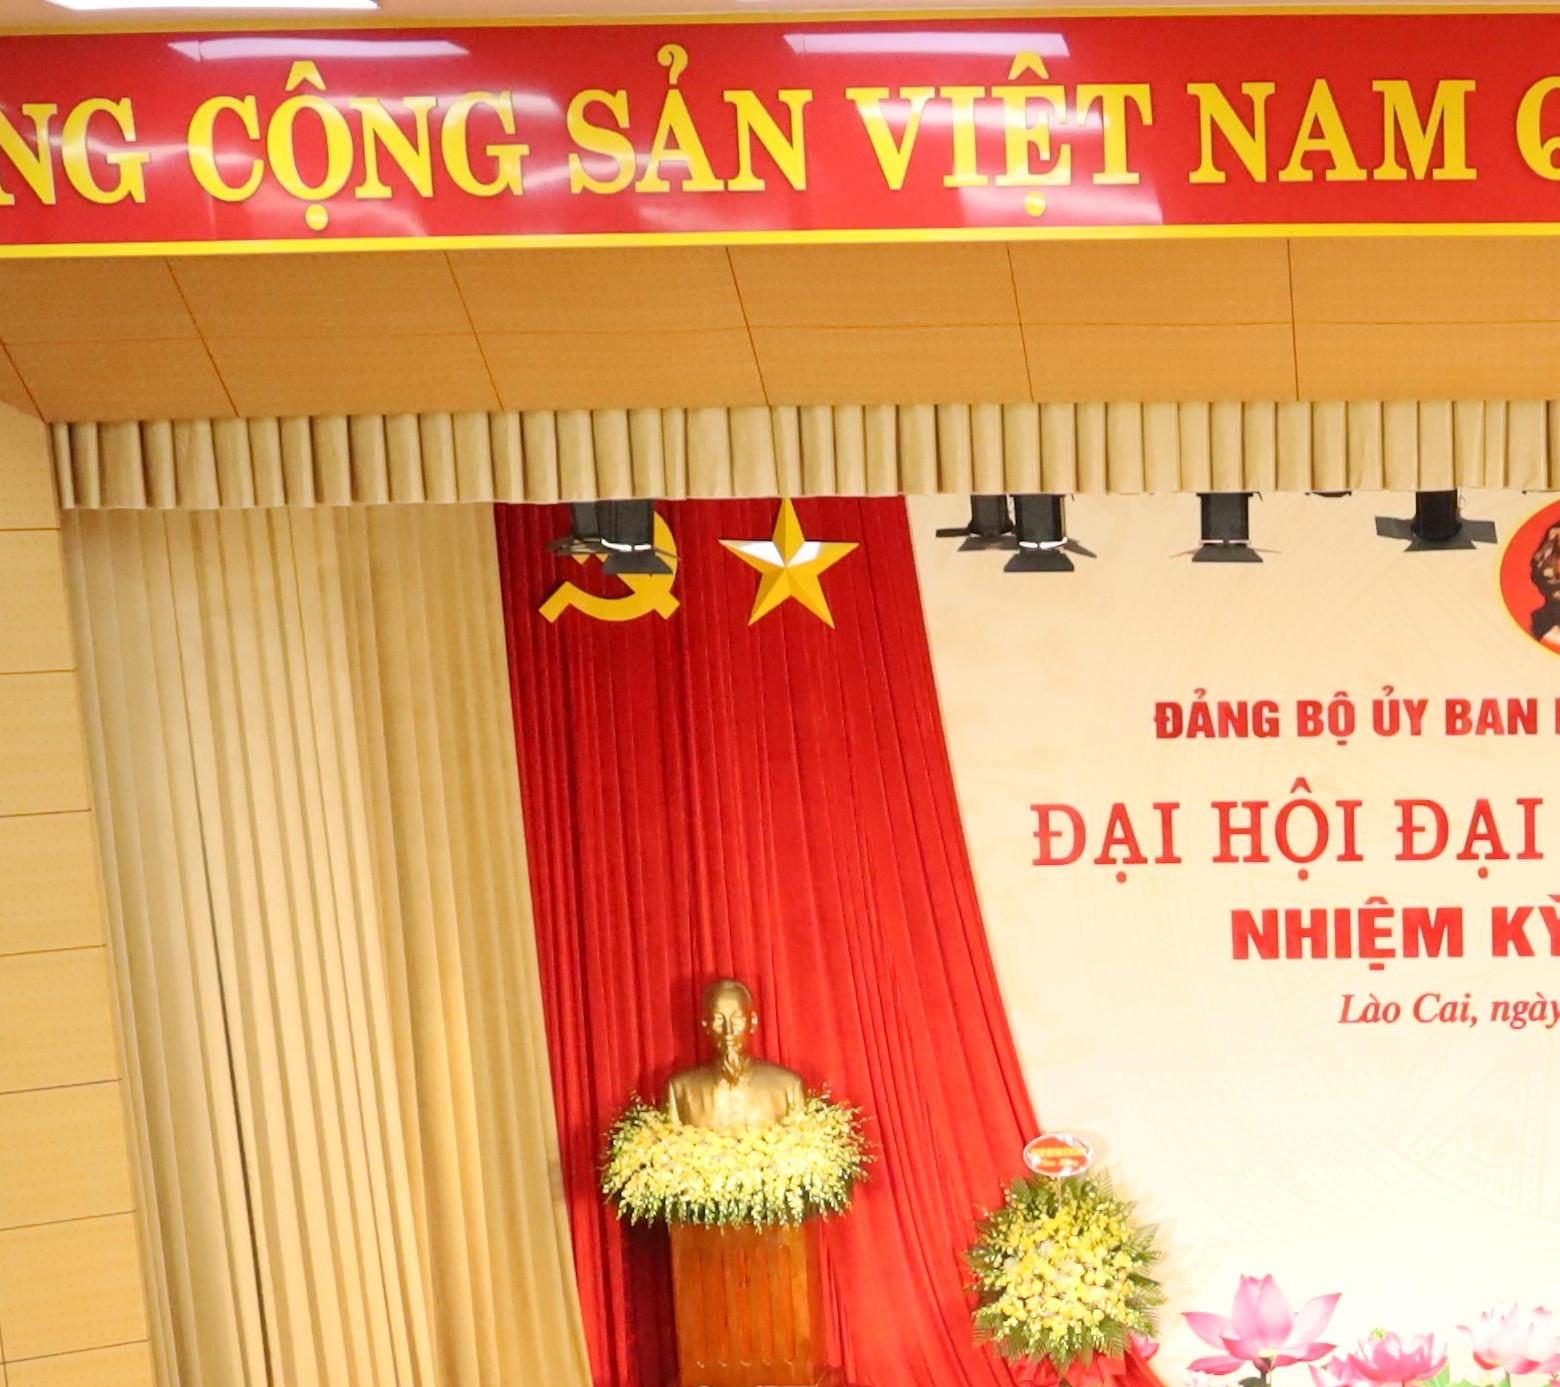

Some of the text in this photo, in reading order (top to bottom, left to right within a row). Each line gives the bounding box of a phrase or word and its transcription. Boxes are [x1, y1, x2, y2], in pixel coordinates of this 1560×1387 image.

[187, 60, 530, 230] CỘNG
[567, 44, 813, 194] SẢN
[846, 52, 1154, 216] VIỆT
[1187, 79, 1477, 185] NAM
[1152, 686, 1282, 741] ĐẢNG
[1295, 689, 1358, 747] BỘ
[1371, 683, 1430, 738] ỦY
[1443, 696, 1540, 737] BAN
[1030, 800, 1183, 885] ĐẠI
[1210, 775, 1365, 882] HỘI
[1393, 796, 1545, 881] ĐẠI
[1230, 895, 1465, 972] NHIỆM
[1339, 993, 1402, 1025] Lào
[1412, 992, 1479, 1025] Cai,
